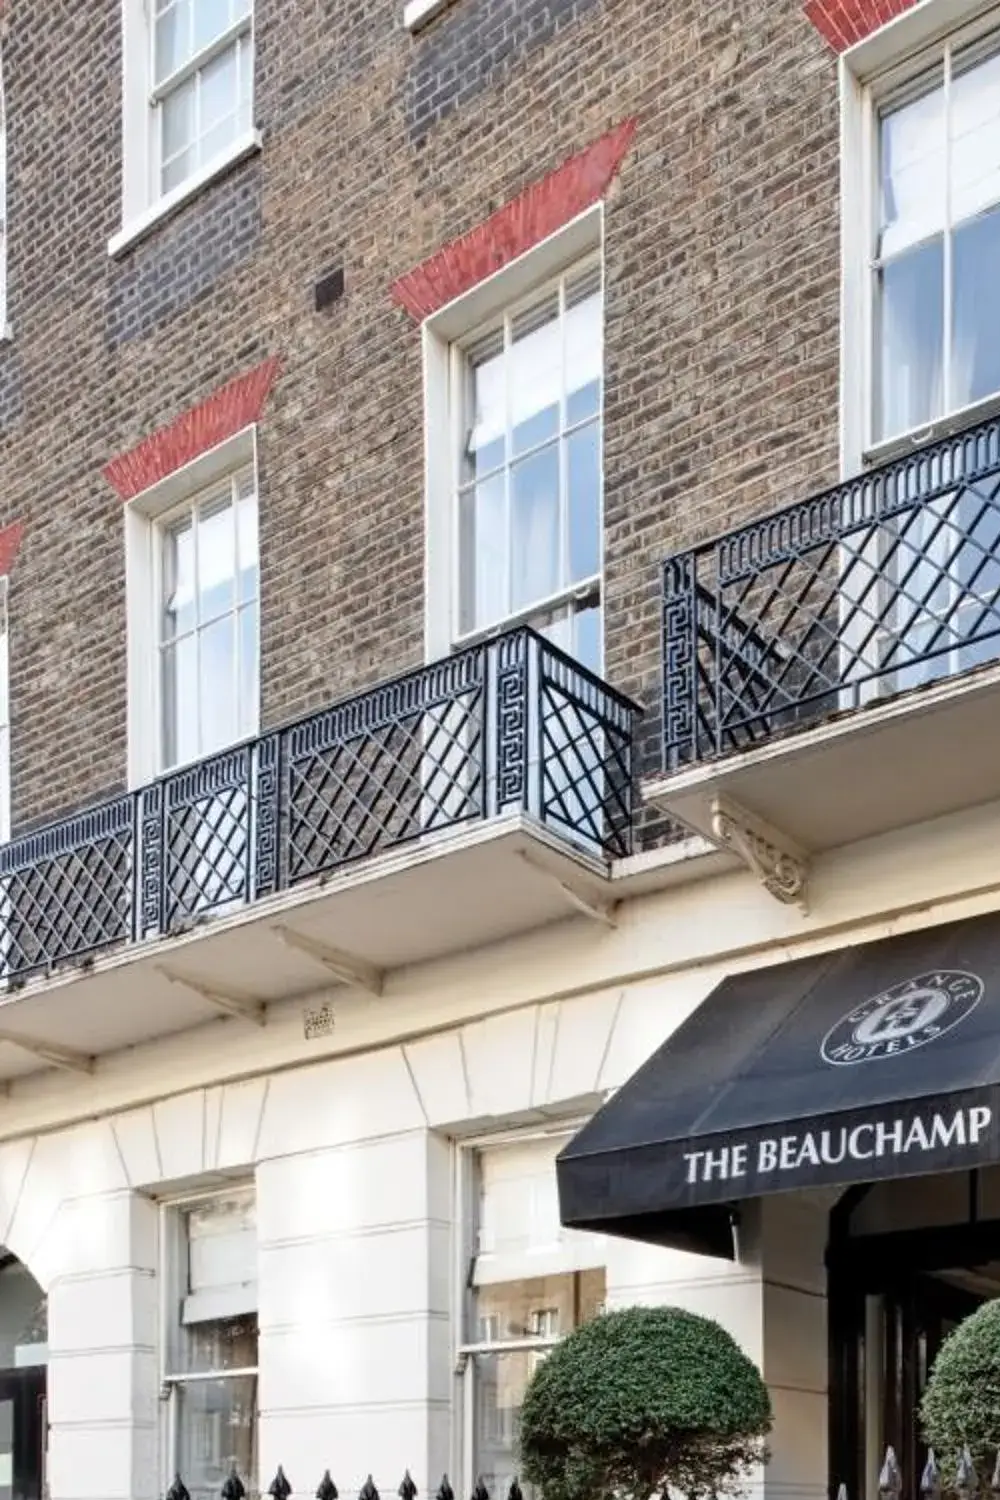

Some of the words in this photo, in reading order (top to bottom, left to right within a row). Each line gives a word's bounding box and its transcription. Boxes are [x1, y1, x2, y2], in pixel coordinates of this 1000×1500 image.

[848, 975, 976, 1023] GRANGE
[829, 1026, 941, 1061] HOTELS
[683, 1143, 749, 1184] THE
[757, 1106, 993, 1173] BEAUCHAMP
